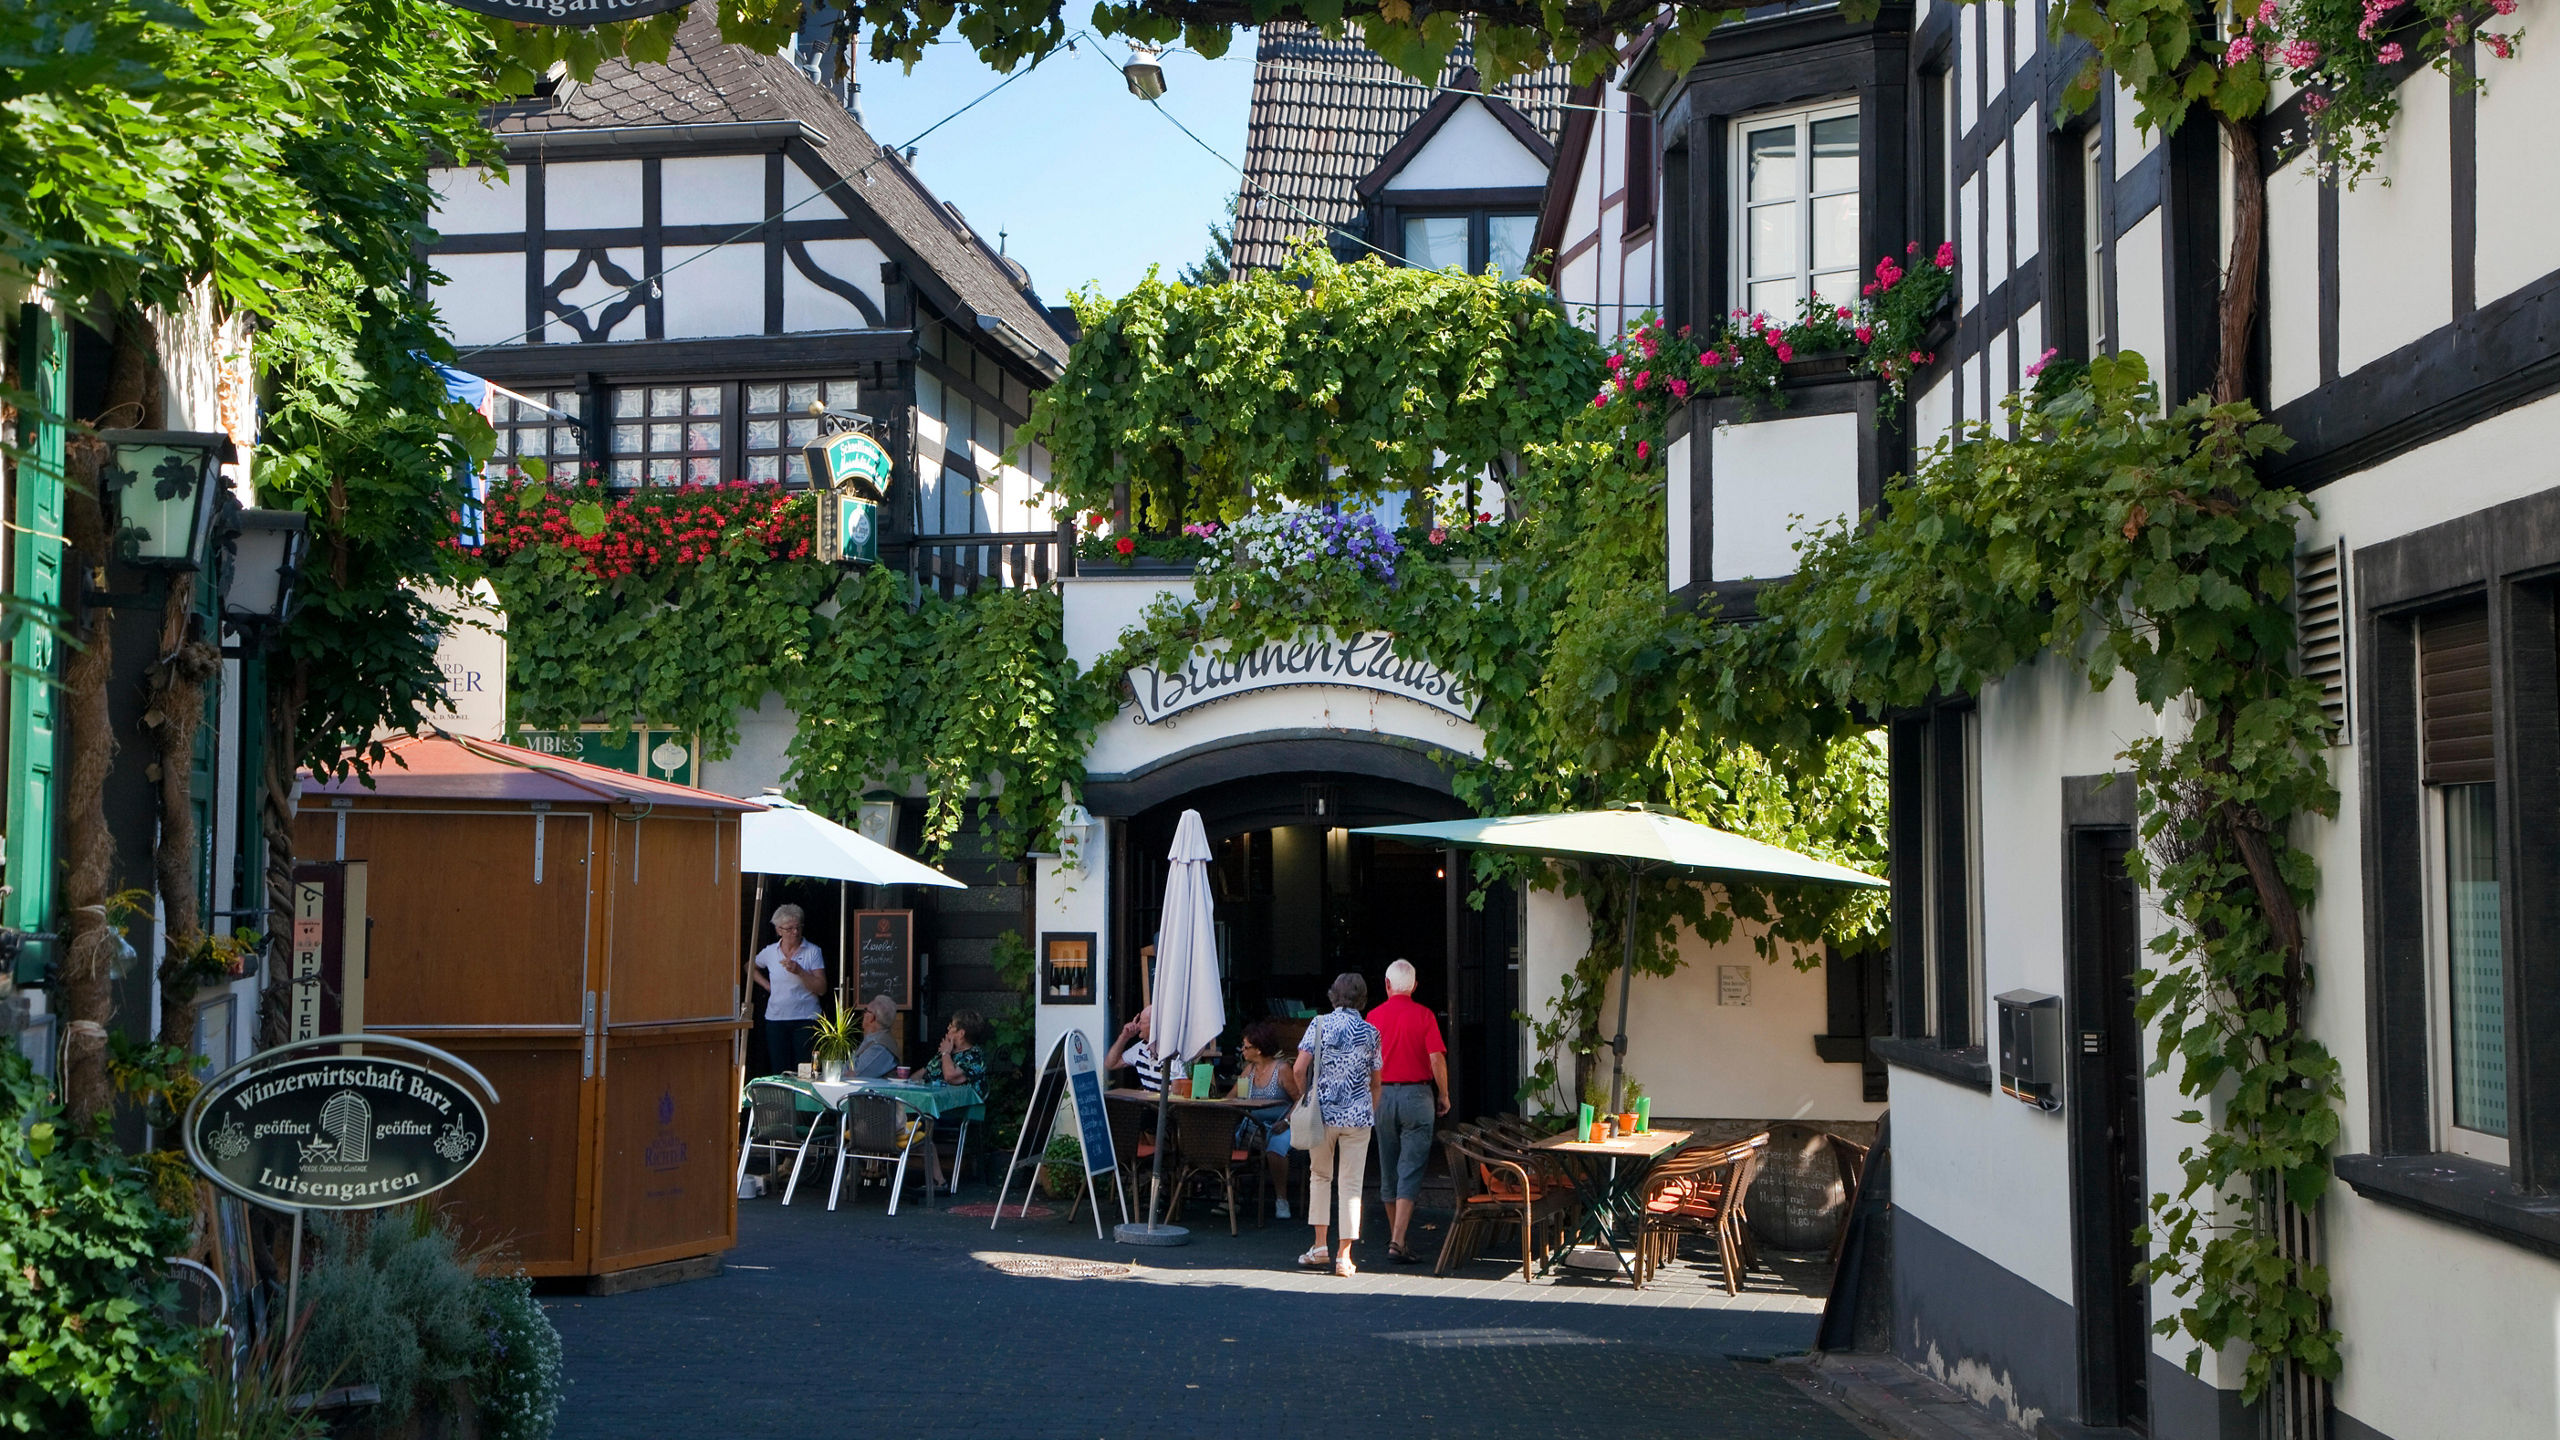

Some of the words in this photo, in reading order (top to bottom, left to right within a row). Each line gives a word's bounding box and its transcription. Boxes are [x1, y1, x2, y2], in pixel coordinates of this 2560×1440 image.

[299, 889, 316, 1041] CIRETTEN
[234, 1065, 405, 1112] Winzerwirtschaft
[407, 1075, 453, 1116] Barz
[254, 1119, 311, 1139] geöffnet
[376, 1119, 433, 1139] geöffnet
[258, 1167, 421, 1202] Luisengarten
[1790, 1194, 1808, 1206] mit
